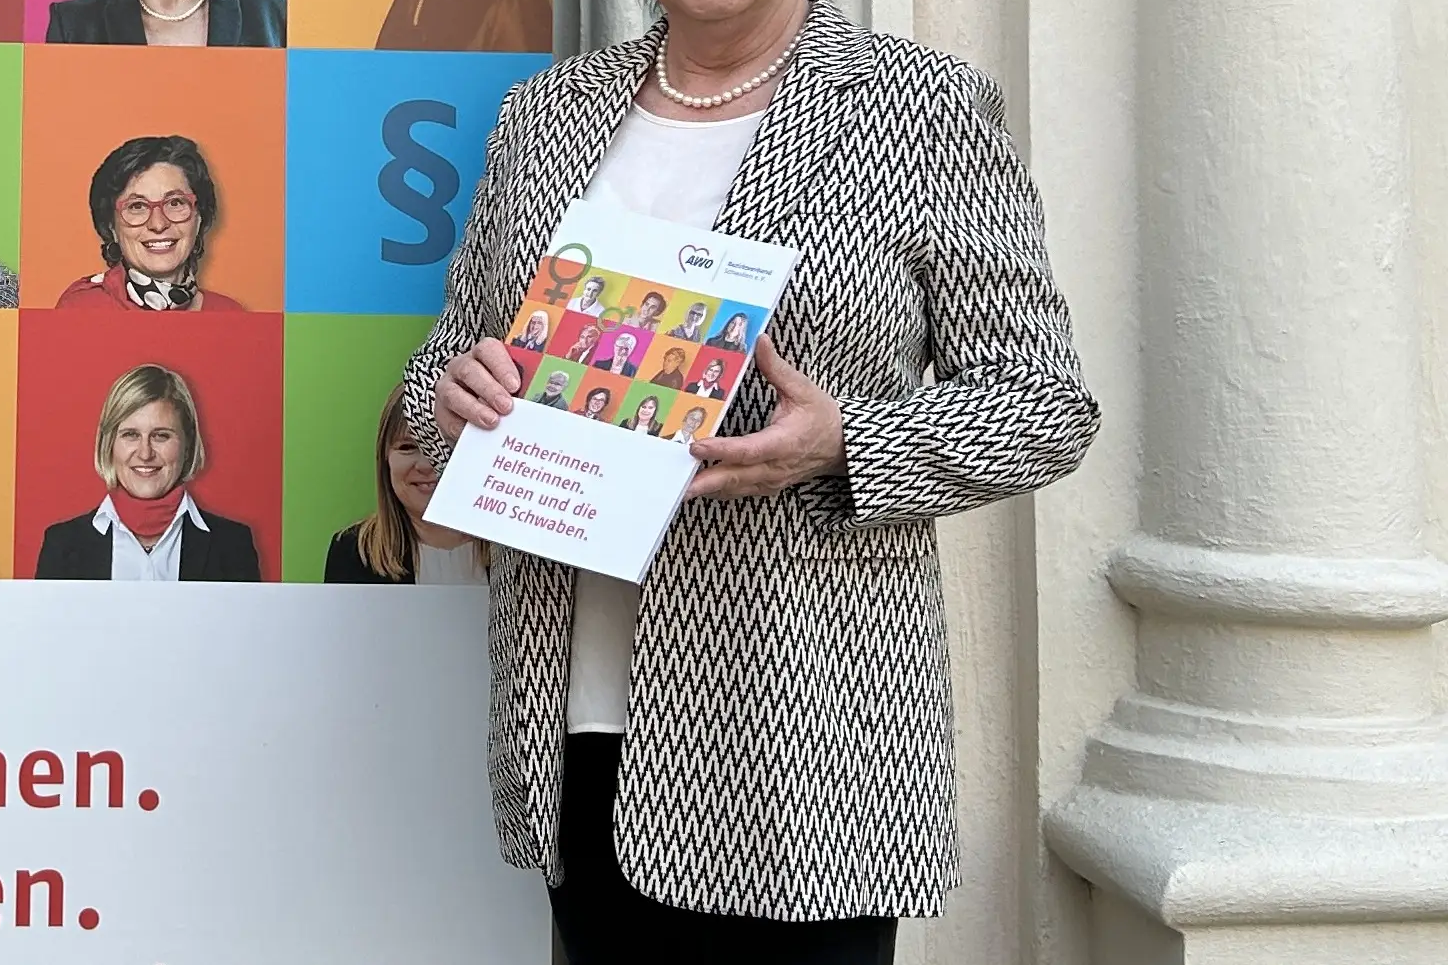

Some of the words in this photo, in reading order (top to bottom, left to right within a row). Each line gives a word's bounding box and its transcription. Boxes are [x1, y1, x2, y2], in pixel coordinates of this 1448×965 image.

[685, 255, 714, 269] AWO
[492, 455, 584, 495] Helferinnen.
[501, 435, 604, 477] Macherinnen.
[473, 495, 507, 515] AWO
[509, 505, 588, 541] Schwaben.
[483, 474, 535, 501] Frauen
[538, 494, 571, 512] und
[572, 502, 597, 520] die
